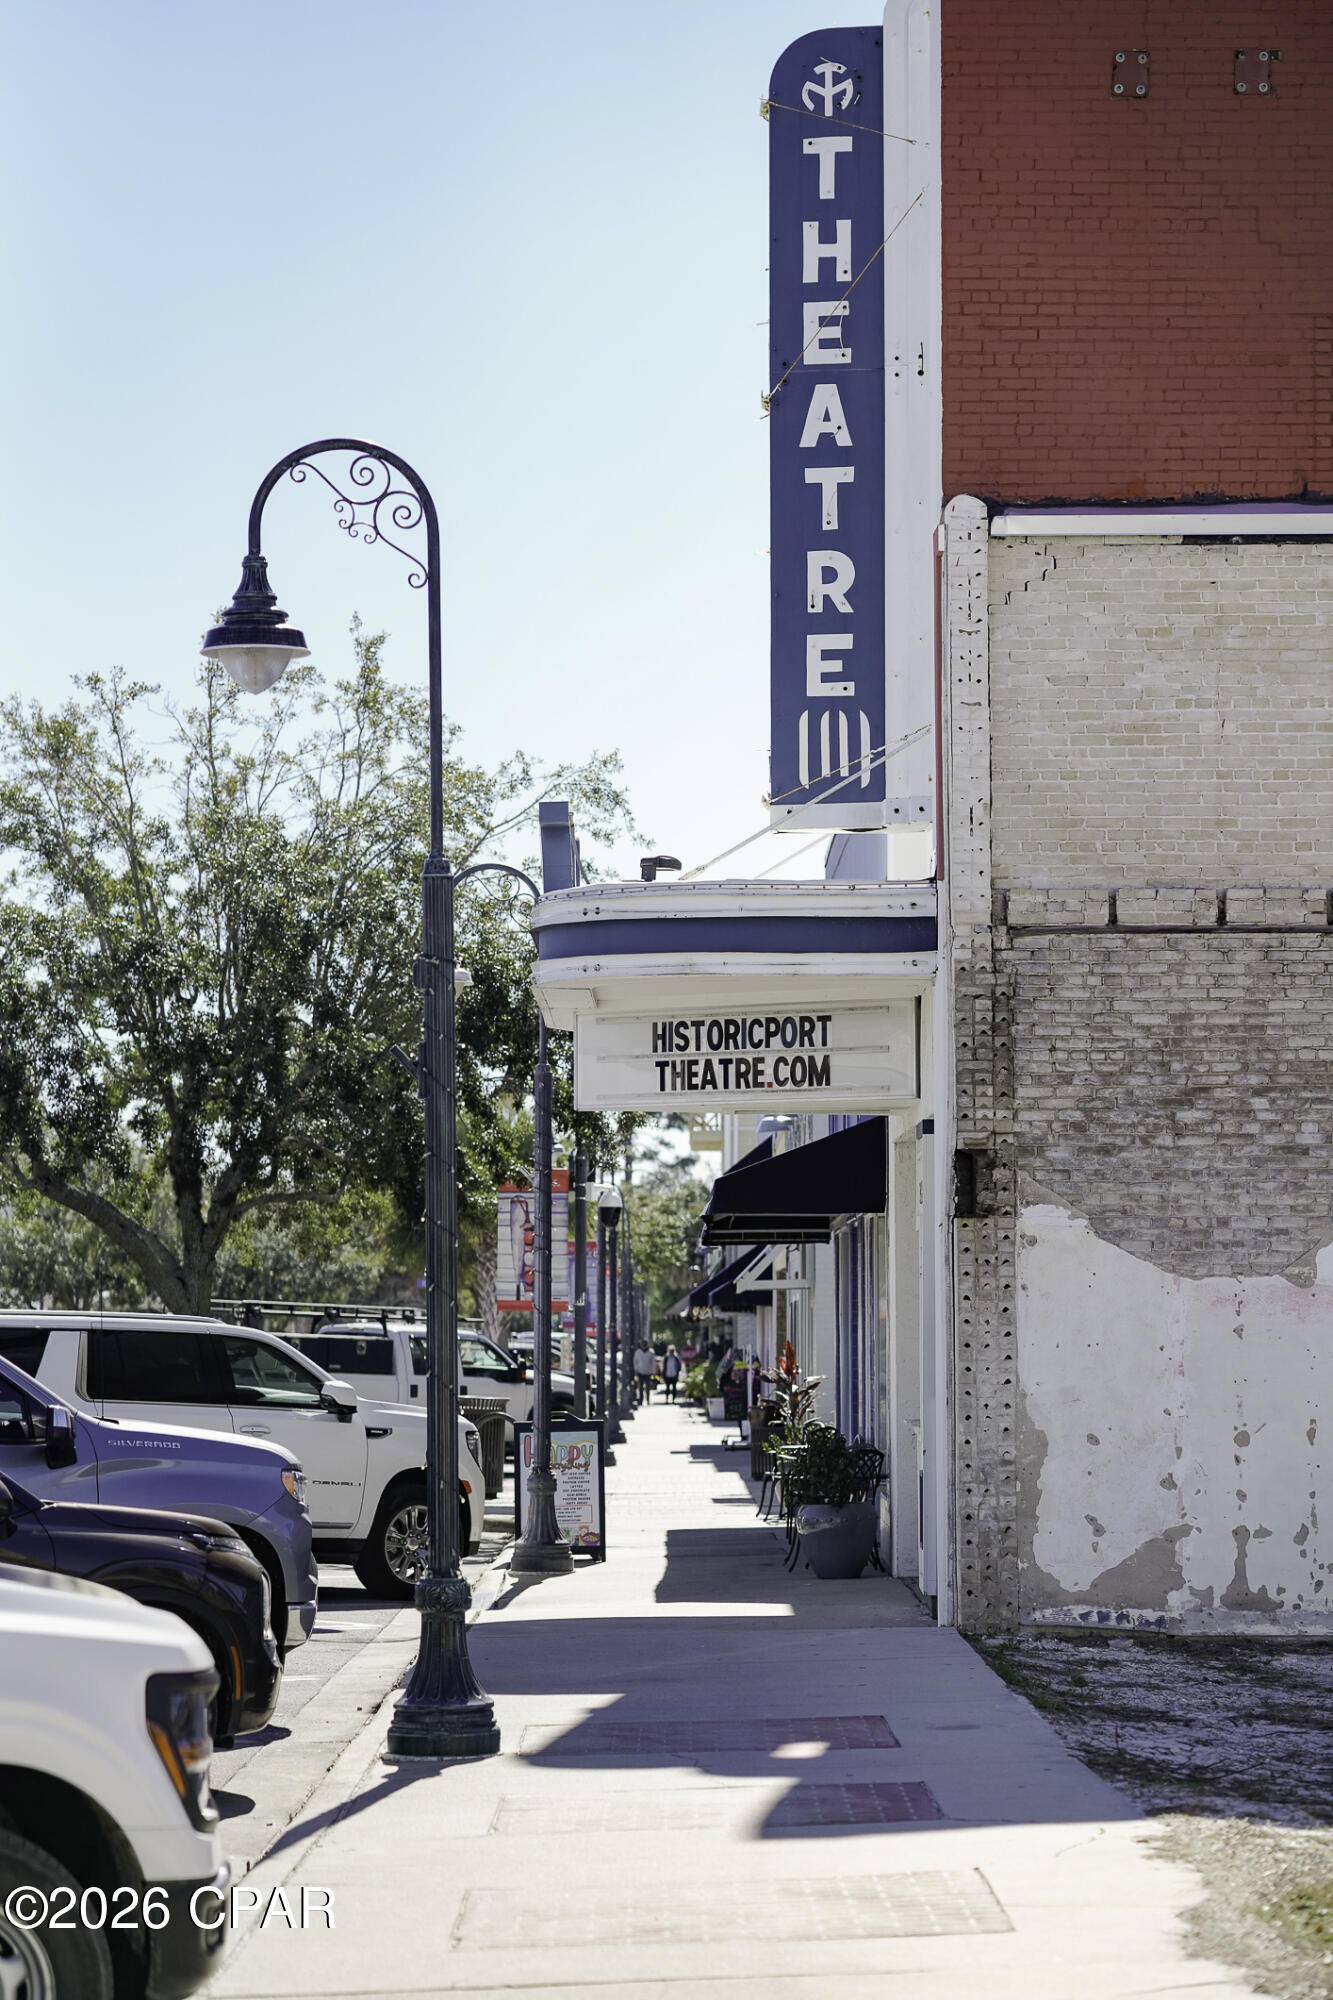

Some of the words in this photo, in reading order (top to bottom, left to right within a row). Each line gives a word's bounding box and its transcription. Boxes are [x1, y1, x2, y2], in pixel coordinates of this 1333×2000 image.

[799, 136, 856, 697] THEATRE
[652, 1015, 832, 1053] HISTORICPORT
[655, 1054, 831, 1092] THEATRE.COM
[107, 1440, 181, 1449] SILVERADO
